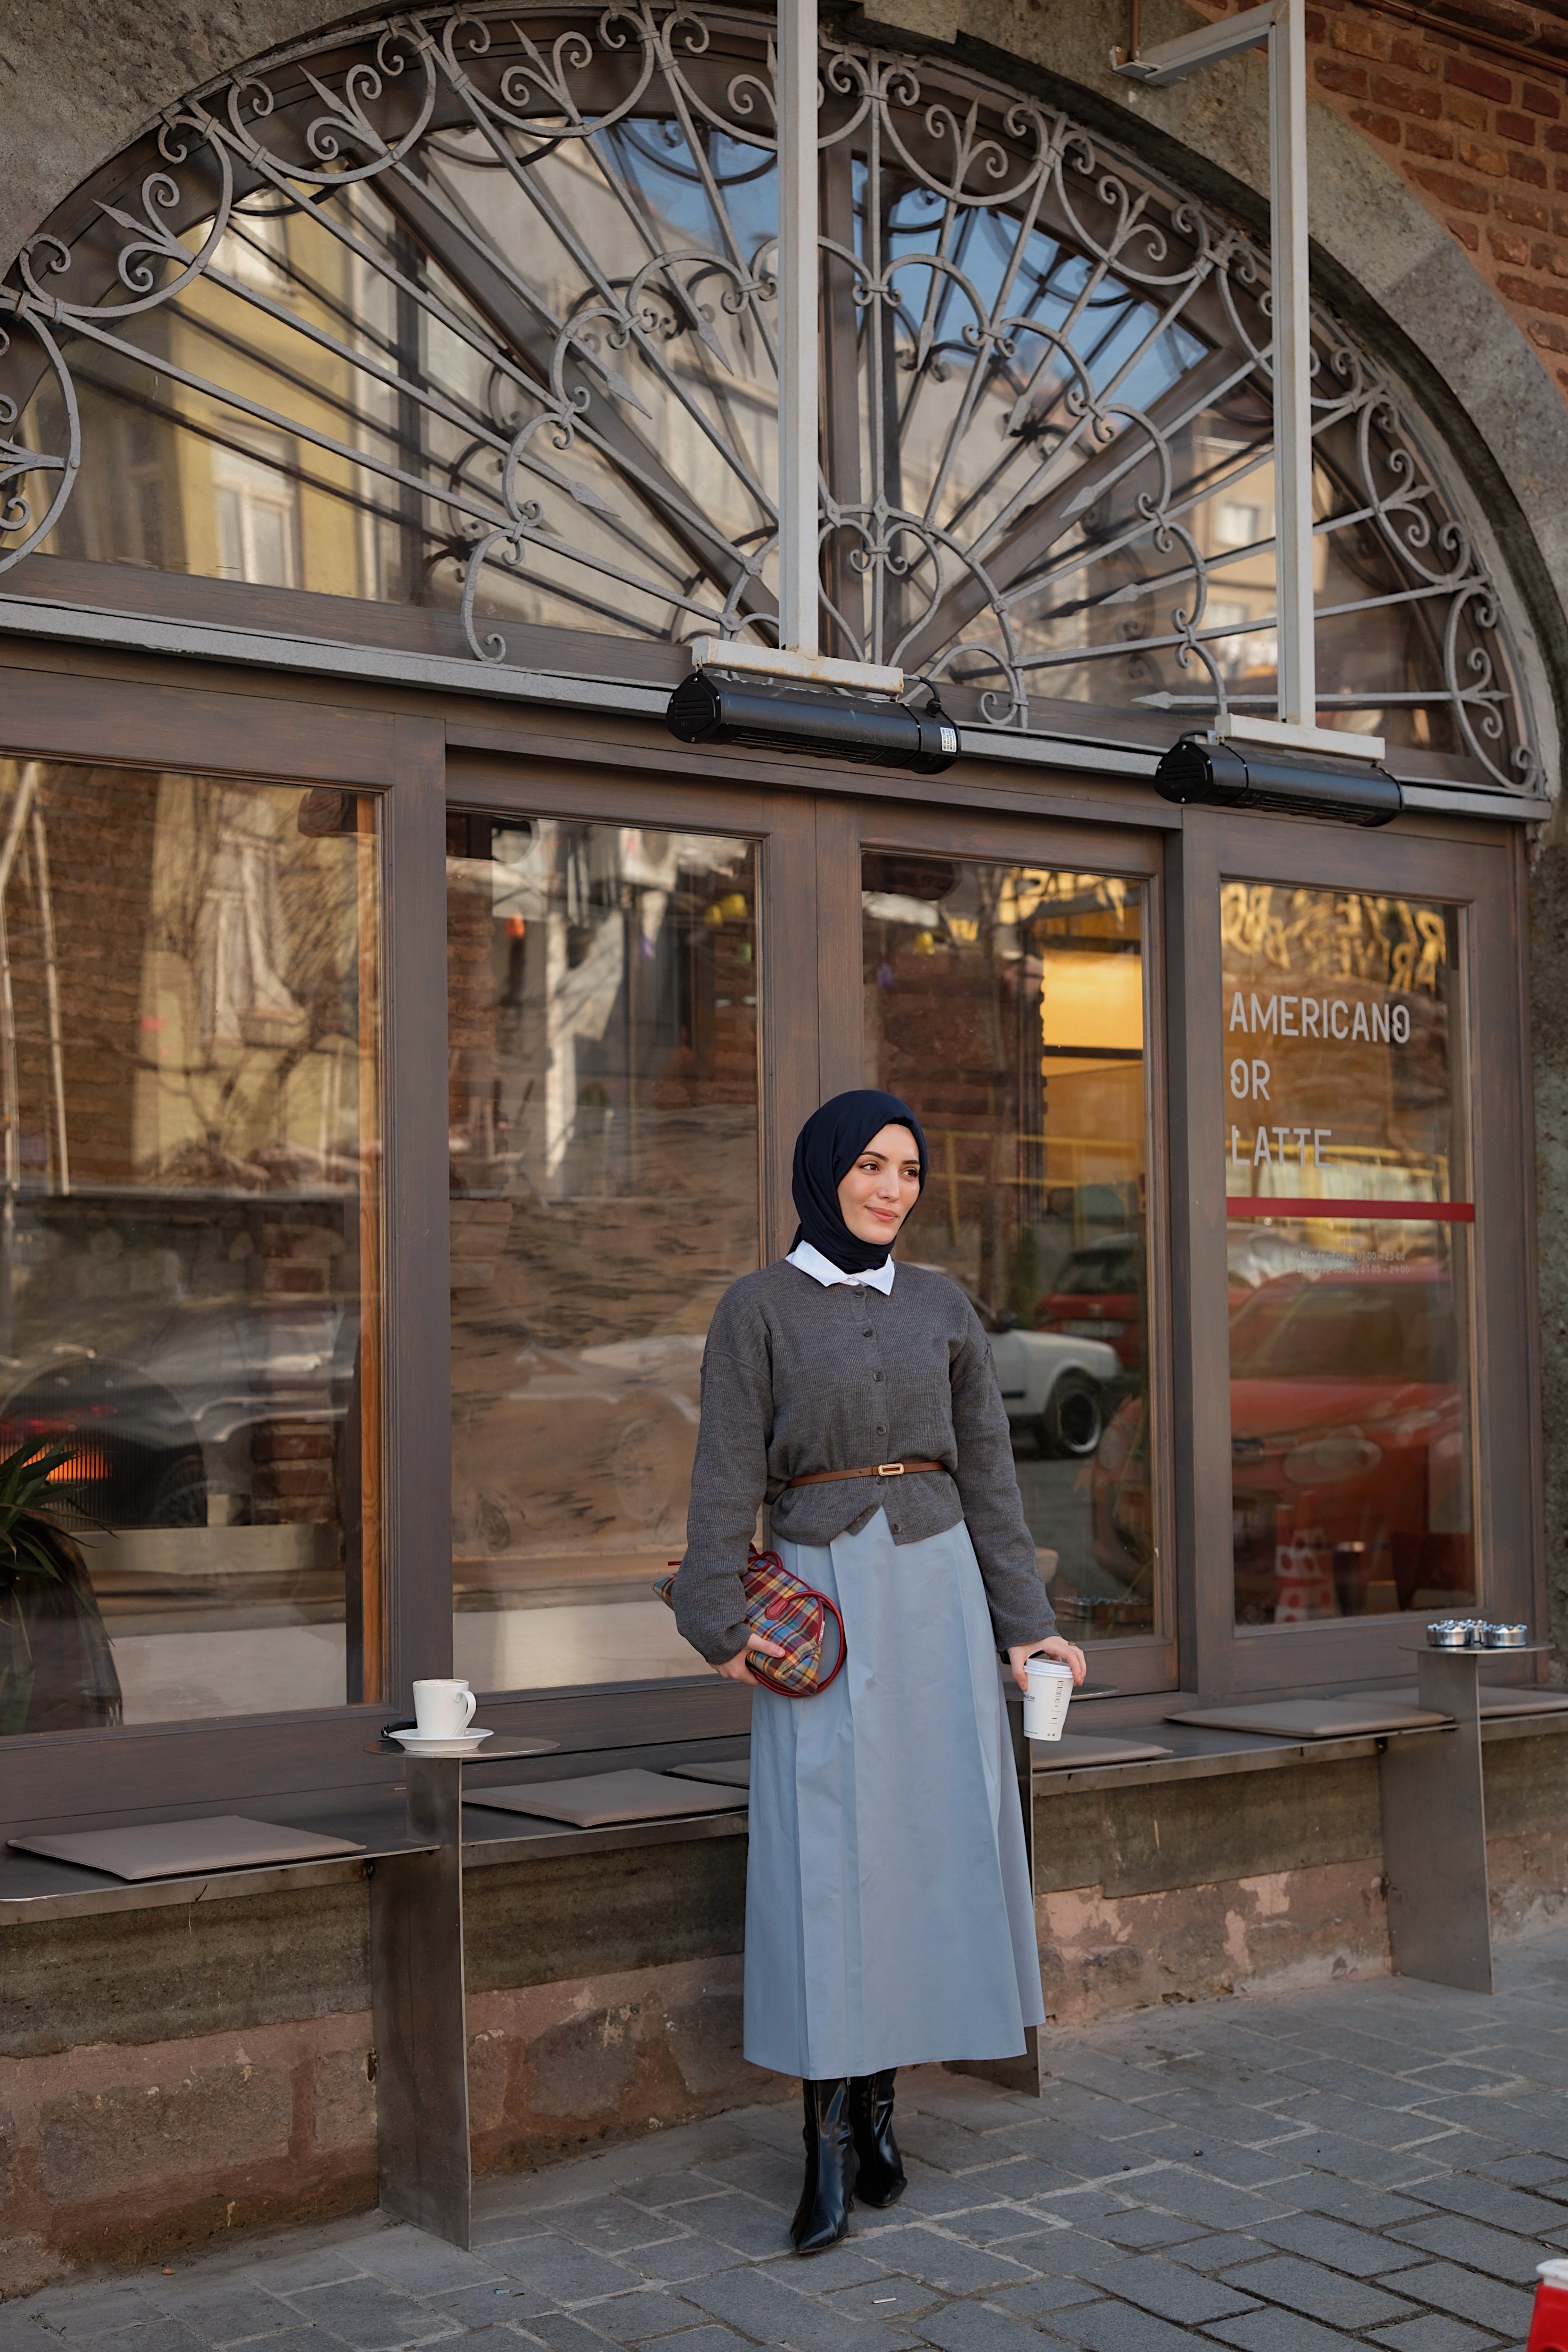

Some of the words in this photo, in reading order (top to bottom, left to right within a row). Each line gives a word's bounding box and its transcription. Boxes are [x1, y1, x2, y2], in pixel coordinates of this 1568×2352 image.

[1229, 992, 1410, 1044] AMERICANO
[1230, 1058, 1271, 1101] OR
[1231, 1125, 1332, 1169] LATTE
